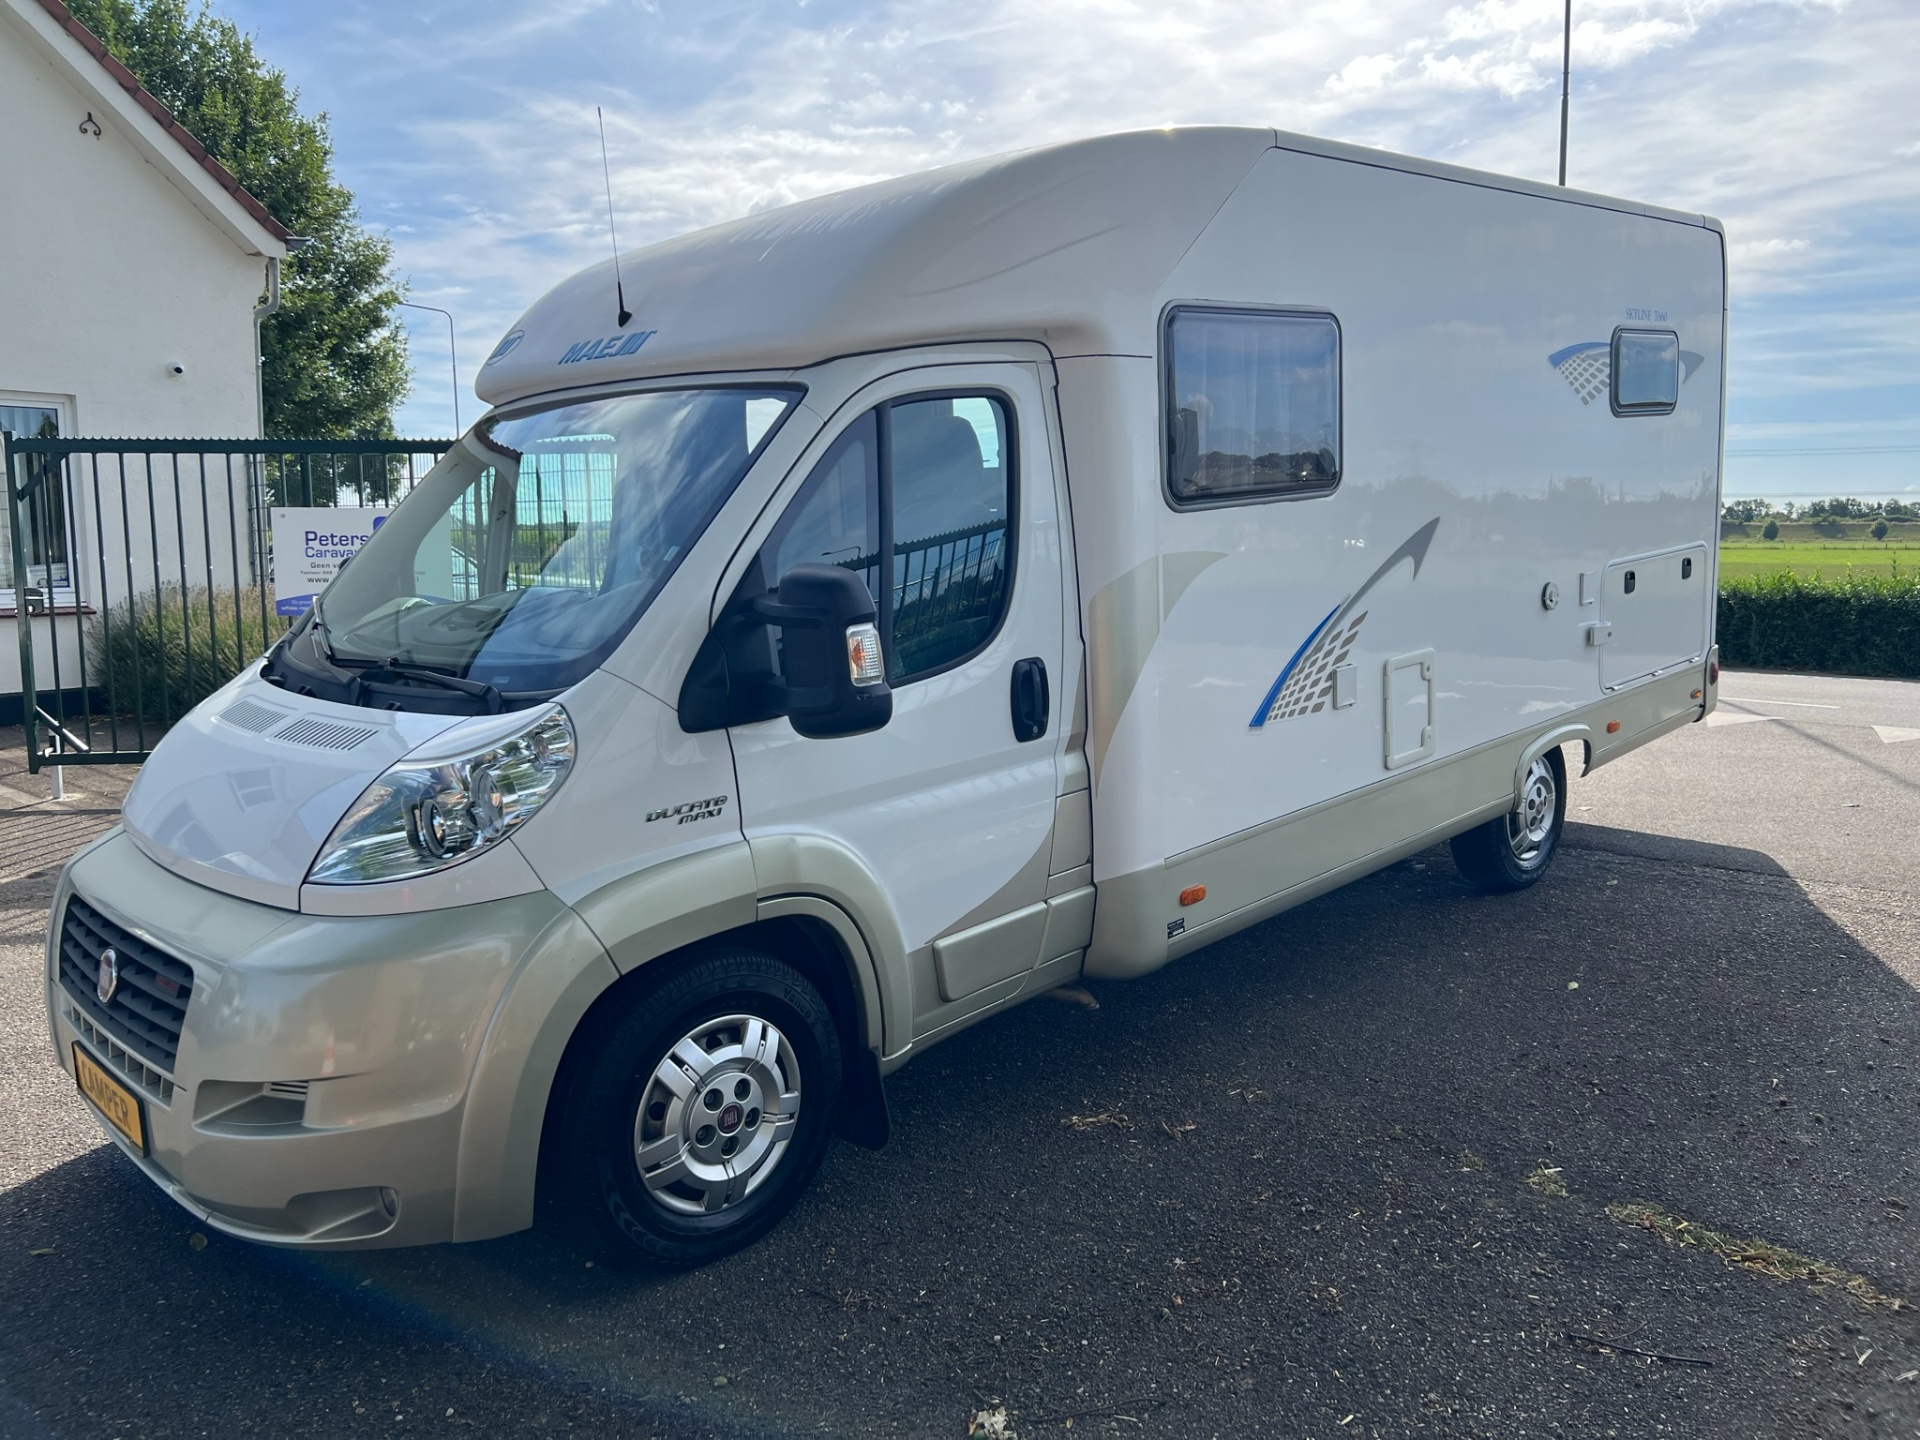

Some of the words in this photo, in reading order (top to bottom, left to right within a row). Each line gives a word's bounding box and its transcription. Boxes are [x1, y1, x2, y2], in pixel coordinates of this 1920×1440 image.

[1625, 308, 1652, 321] SKYLINE
[305, 531, 370, 546] Peters
[305, 547, 358, 558] Carava
[645, 795, 728, 822] DUCATO
[677, 807, 722, 825] MAXI
[81, 1060, 131, 1131] CAMPER
[723, 1110, 738, 1127] FIAT
